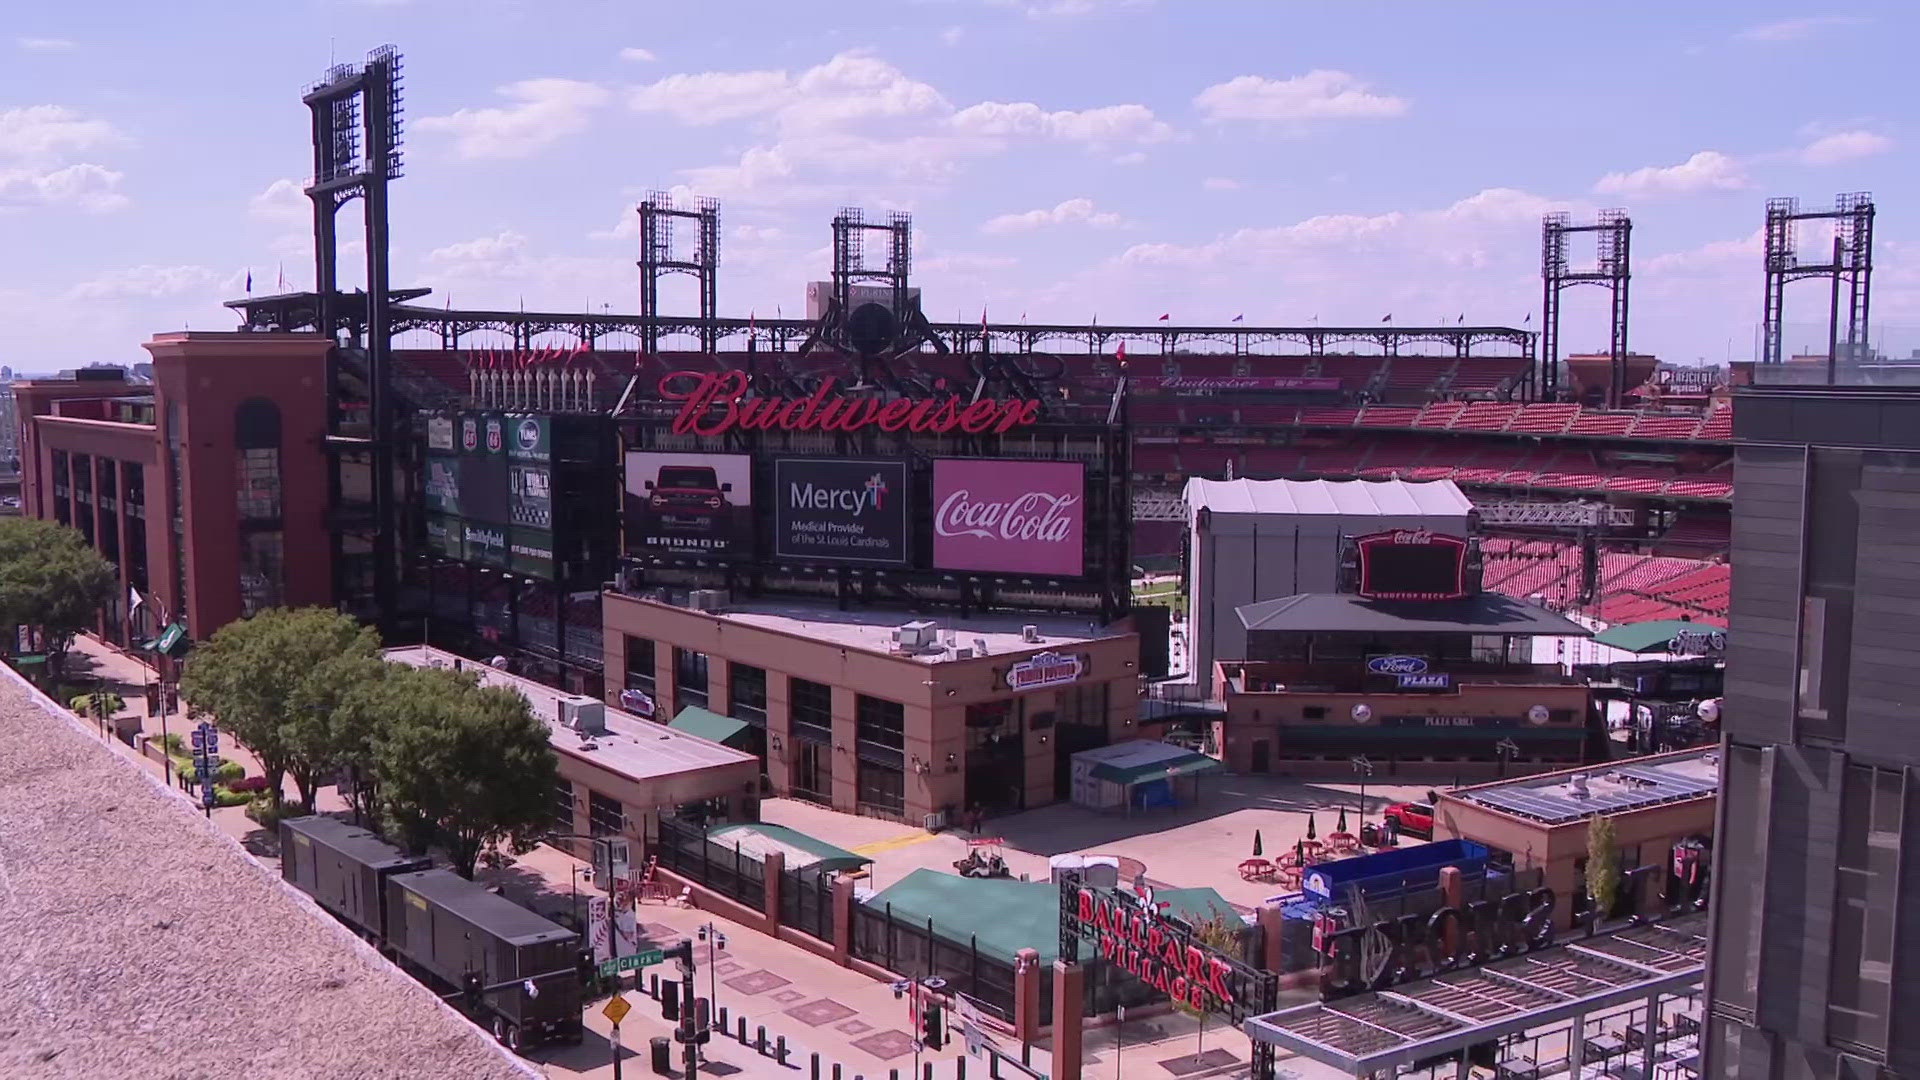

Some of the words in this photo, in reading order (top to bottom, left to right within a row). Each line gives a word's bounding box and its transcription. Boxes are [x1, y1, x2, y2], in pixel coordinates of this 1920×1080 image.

[657, 369, 1040, 436] Budweiser
[790, 481, 867, 517] Mercy
[935, 489, 1080, 542] Coca-Cola
[791, 520, 826, 532] Medical
[828, 521, 864, 534] Provider
[465, 527, 504, 550] Smithfield
[646, 537, 725, 548] BRONCO
[827, 535, 848, 546] Louis
[850, 535, 890, 548] Cardinals
[1394, 531, 1434, 545] Coca-Cola
[1380, 657, 1415, 673] Ford
[1403, 676, 1444, 686] PLAZA
[1424, 717, 1450, 727] PLAZA
[1077, 888, 1234, 1004] BALLPARK
[620, 954, 654, 969] Clark
[1101, 933, 1205, 1012] VILLAGE
